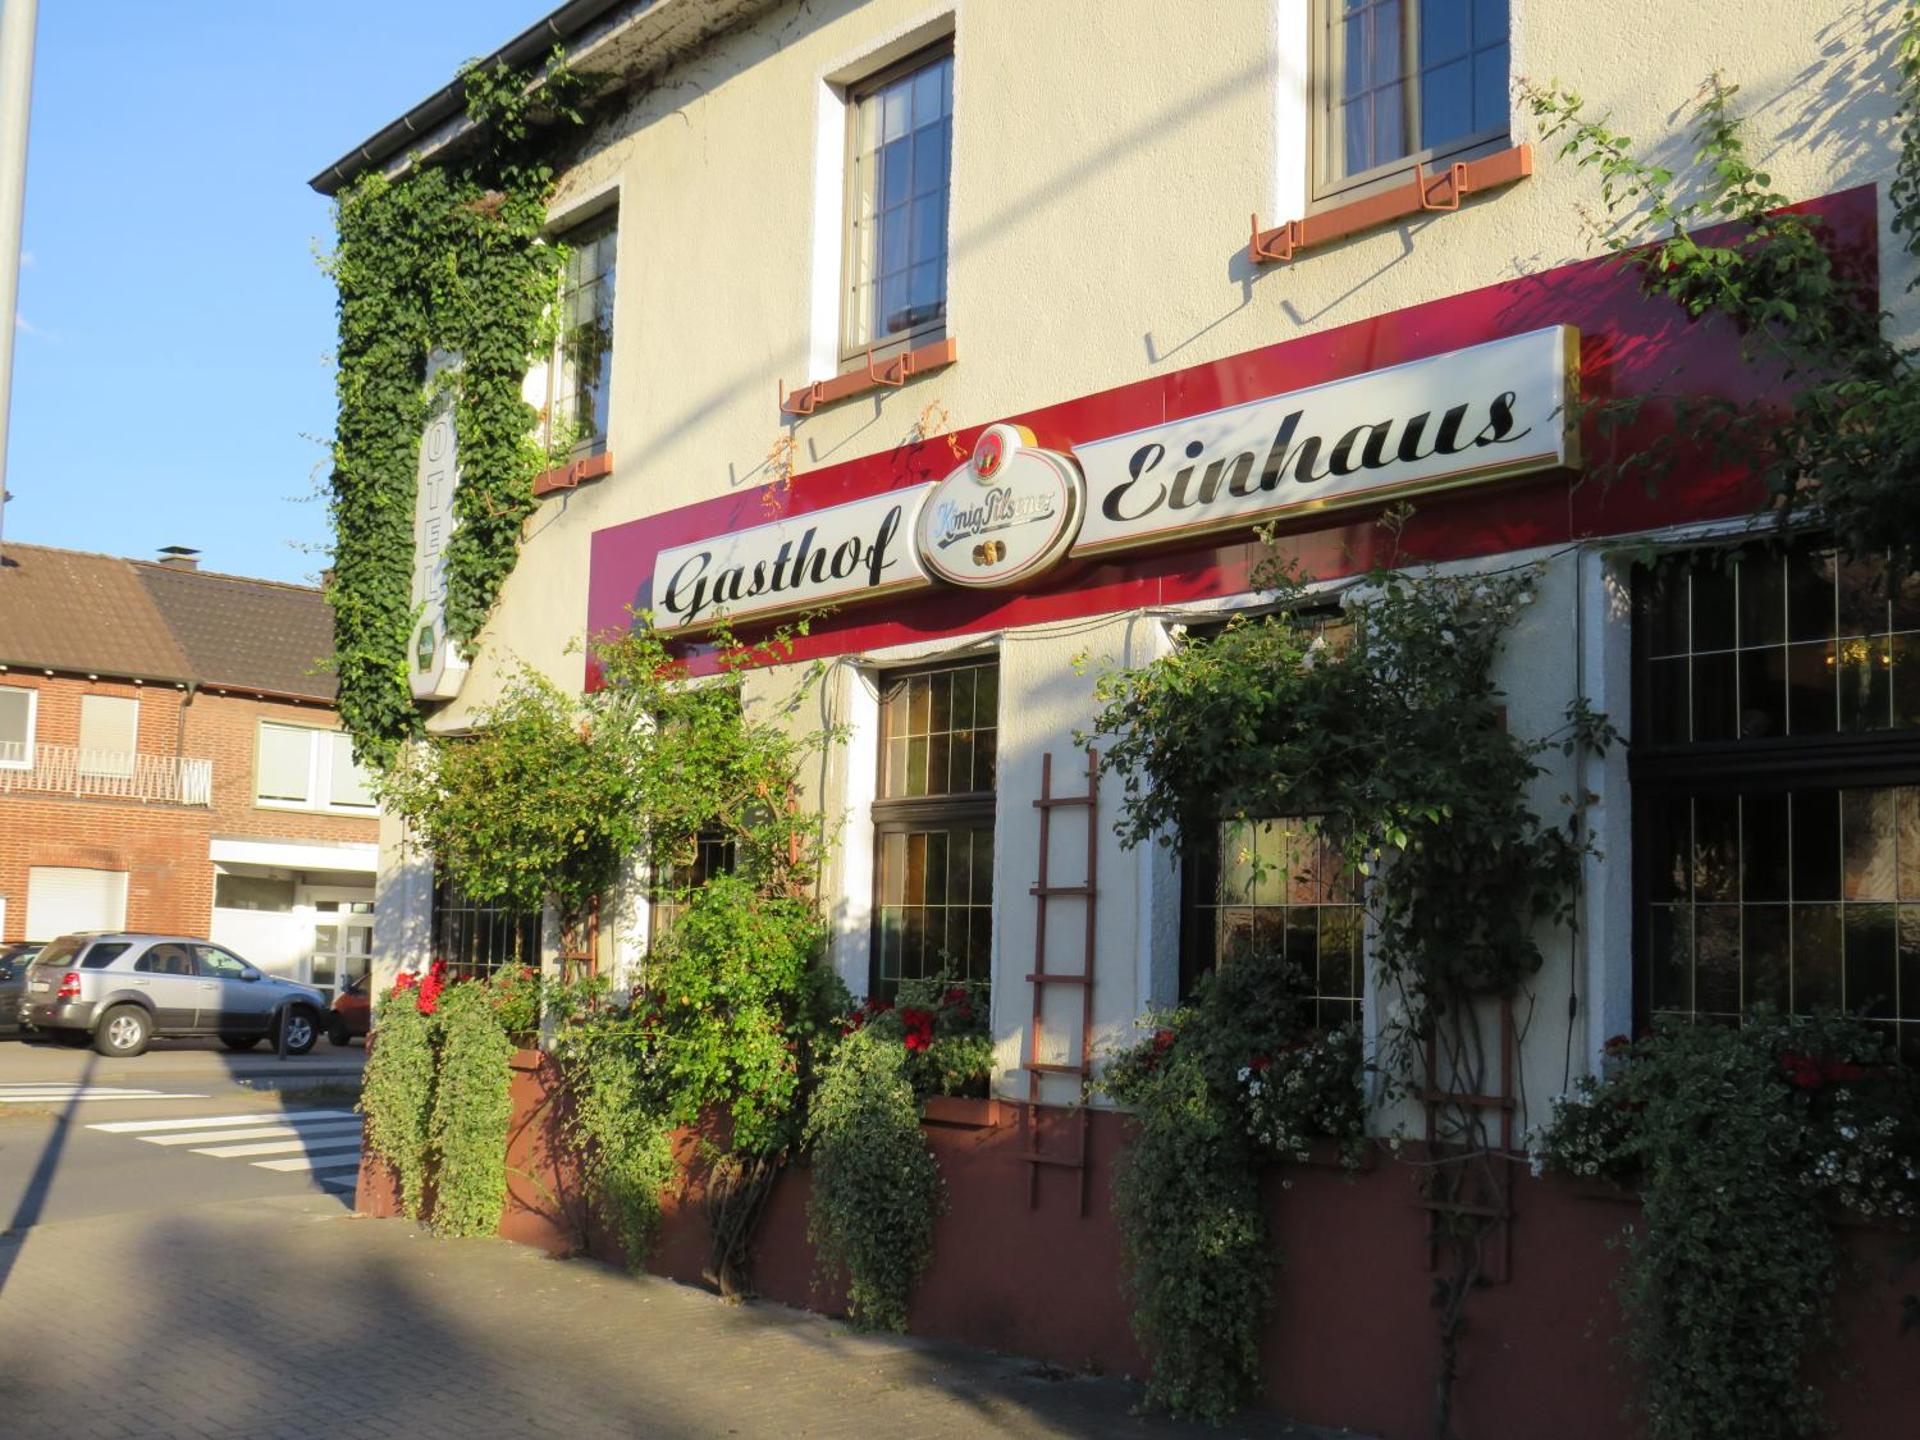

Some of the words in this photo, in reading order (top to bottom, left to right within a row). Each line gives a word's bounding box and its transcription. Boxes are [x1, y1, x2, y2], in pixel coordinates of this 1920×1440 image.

[422, 398, 448, 600] OTEL
[660, 505, 902, 628] Gasthof
[1102, 391, 1532, 521] Einhaus
